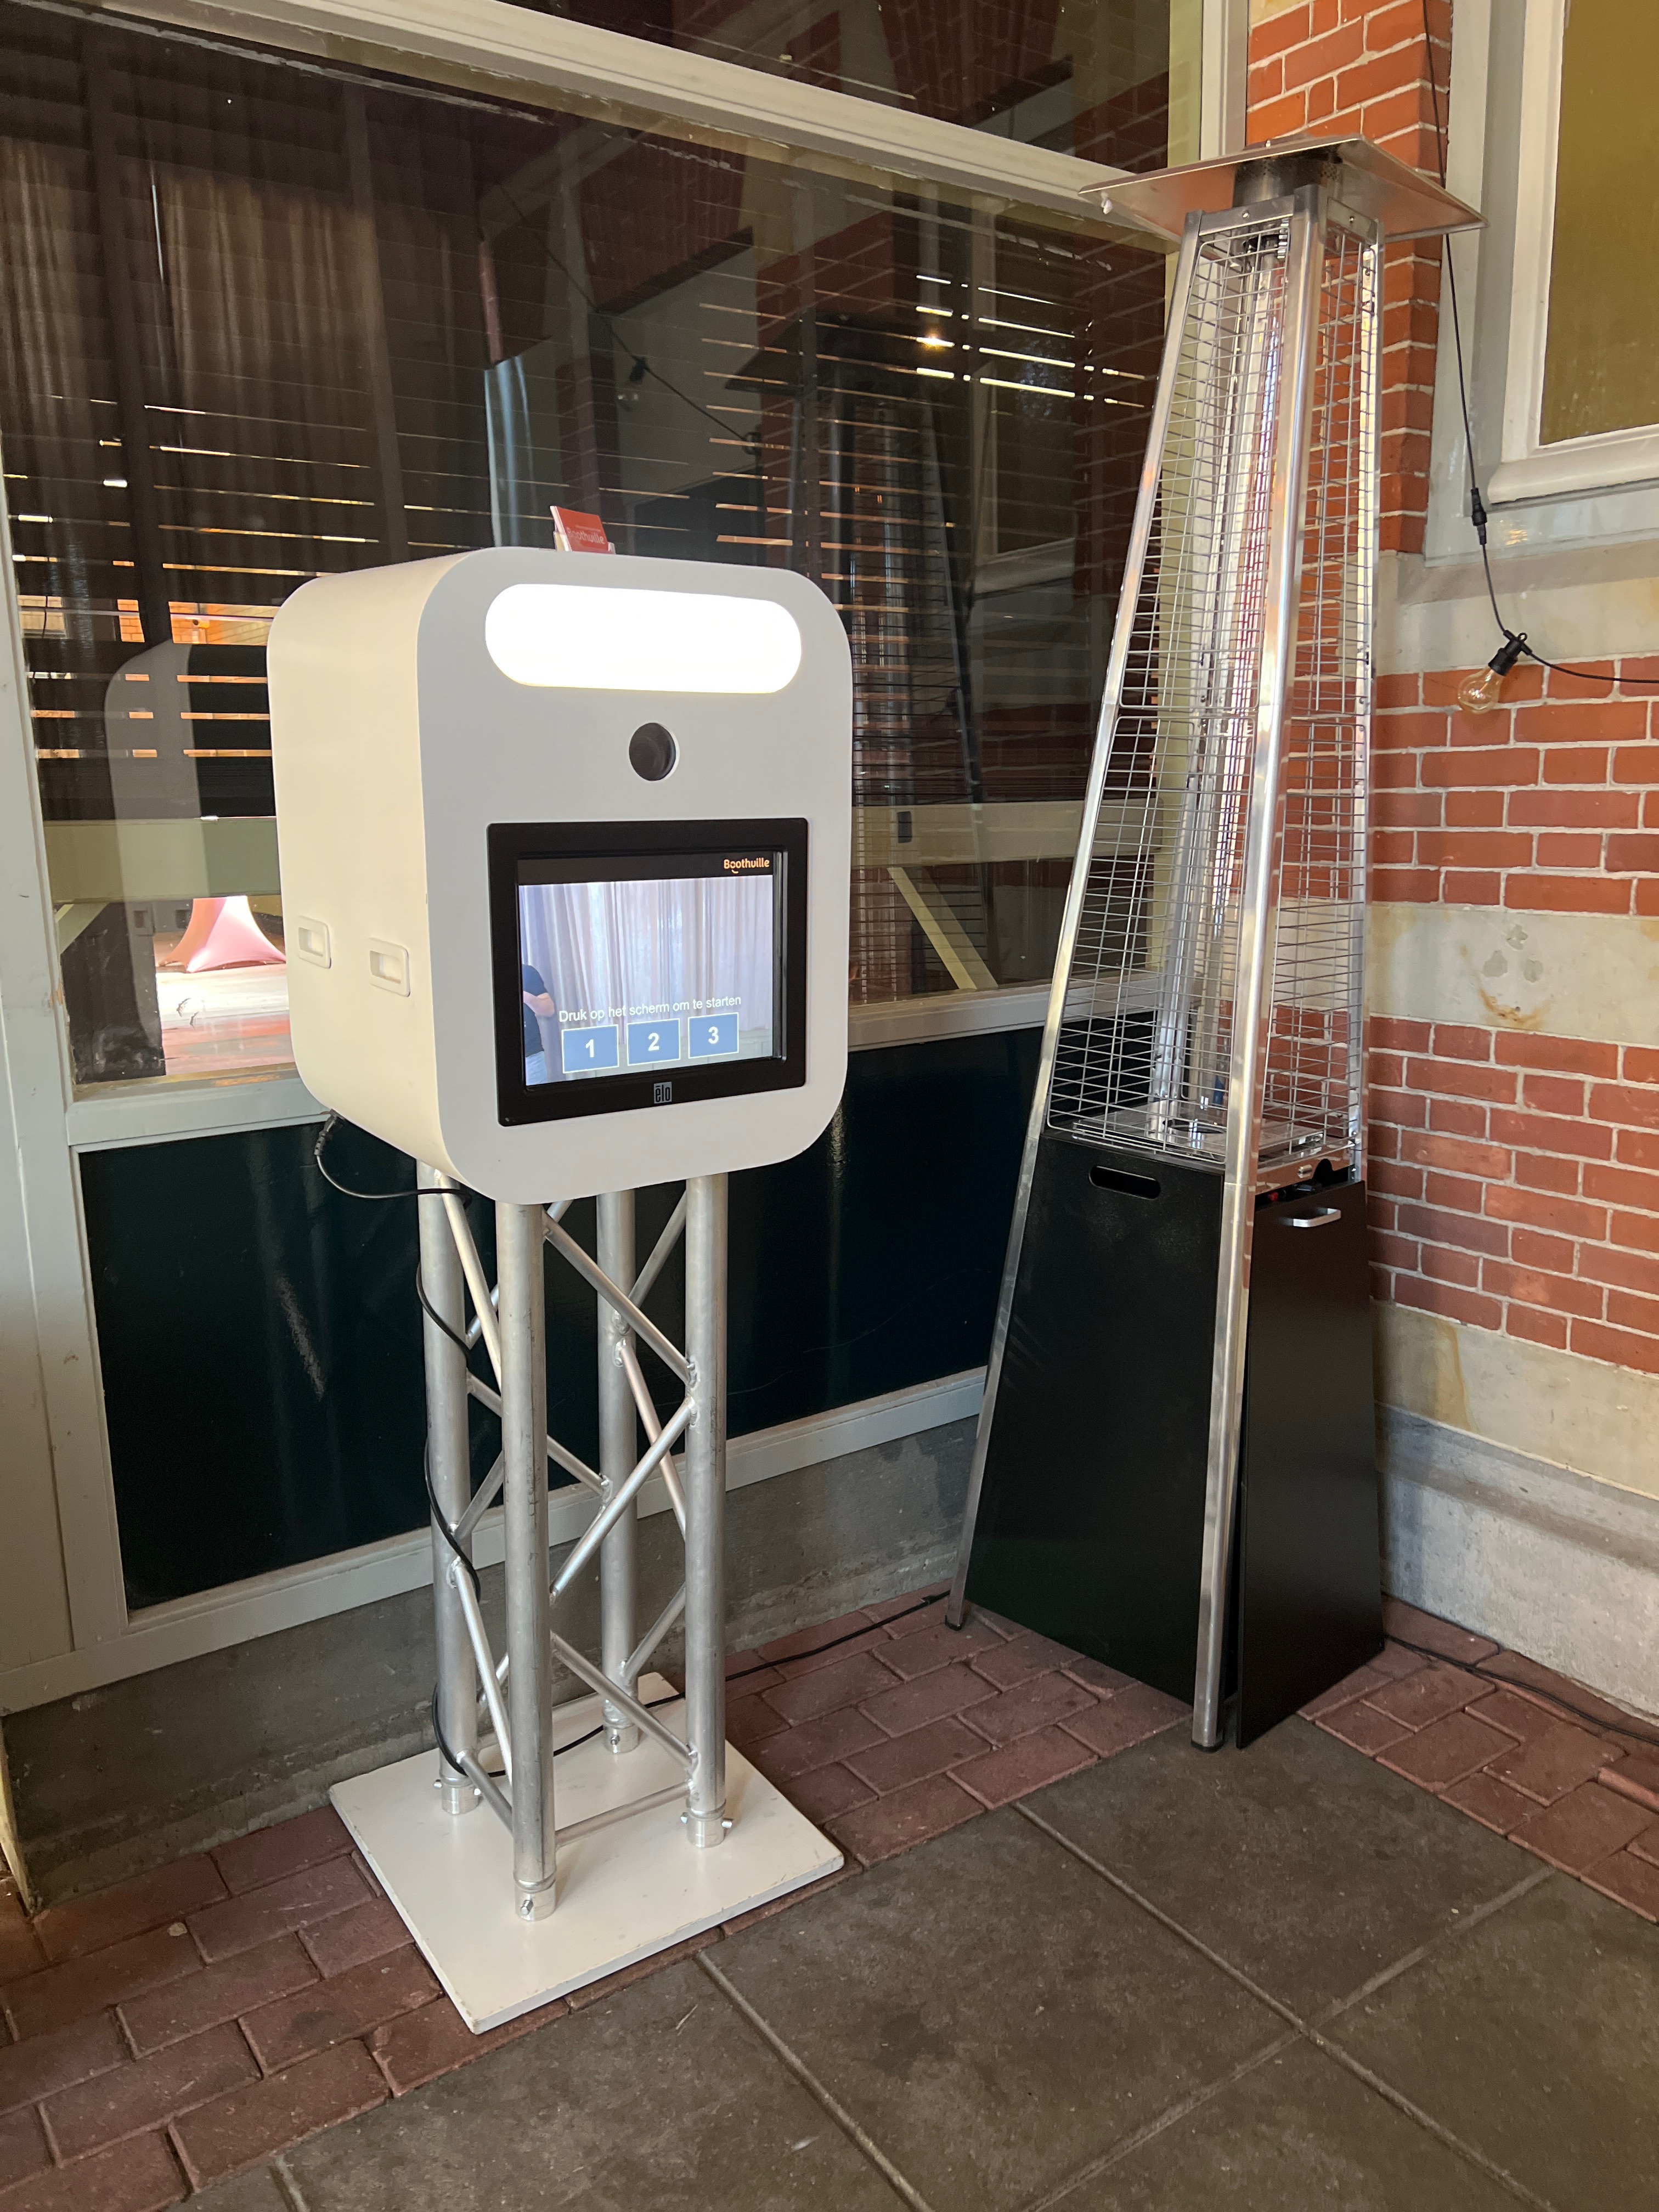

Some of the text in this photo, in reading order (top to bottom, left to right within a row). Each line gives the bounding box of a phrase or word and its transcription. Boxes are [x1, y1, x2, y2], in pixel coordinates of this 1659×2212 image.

[724, 857, 770, 870] Boothville
[558, 996, 741, 1023] Druk op het scherm om te starten
[648, 1032, 659, 1051] 2
[708, 1026, 719, 1044] 3
[585, 1039, 595, 1058] 1
